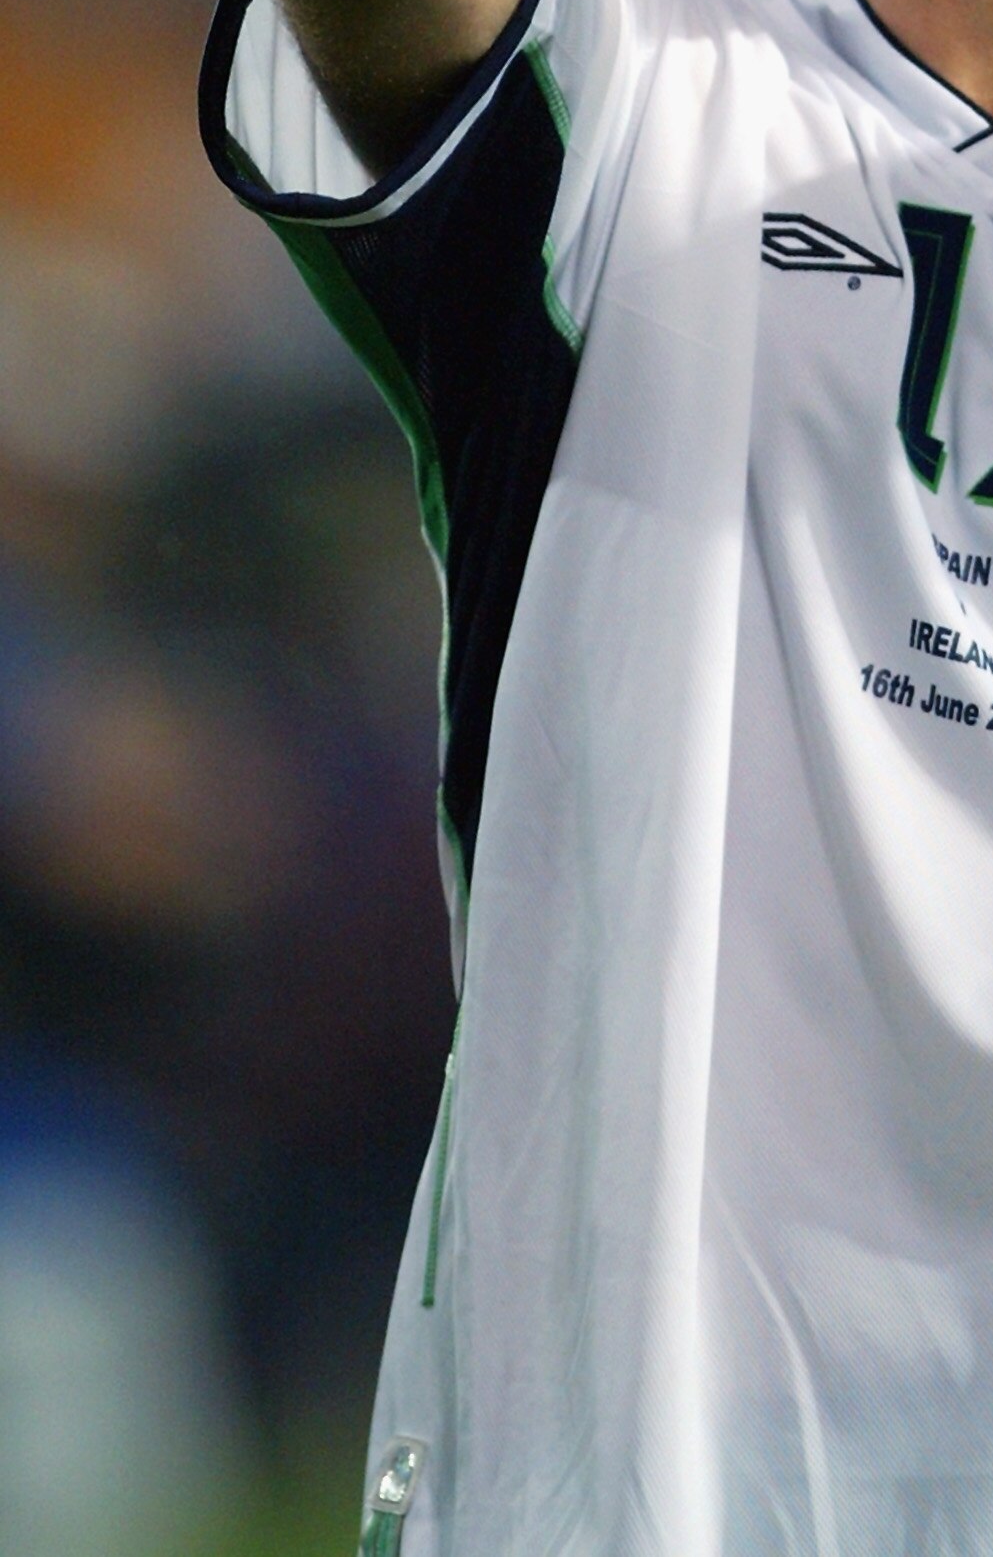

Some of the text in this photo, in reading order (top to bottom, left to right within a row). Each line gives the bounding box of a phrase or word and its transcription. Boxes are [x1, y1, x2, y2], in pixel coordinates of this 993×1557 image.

[931, 532, 992, 587] PAIN
[860, 663, 915, 708] 16th
[920, 684, 980, 727] June
